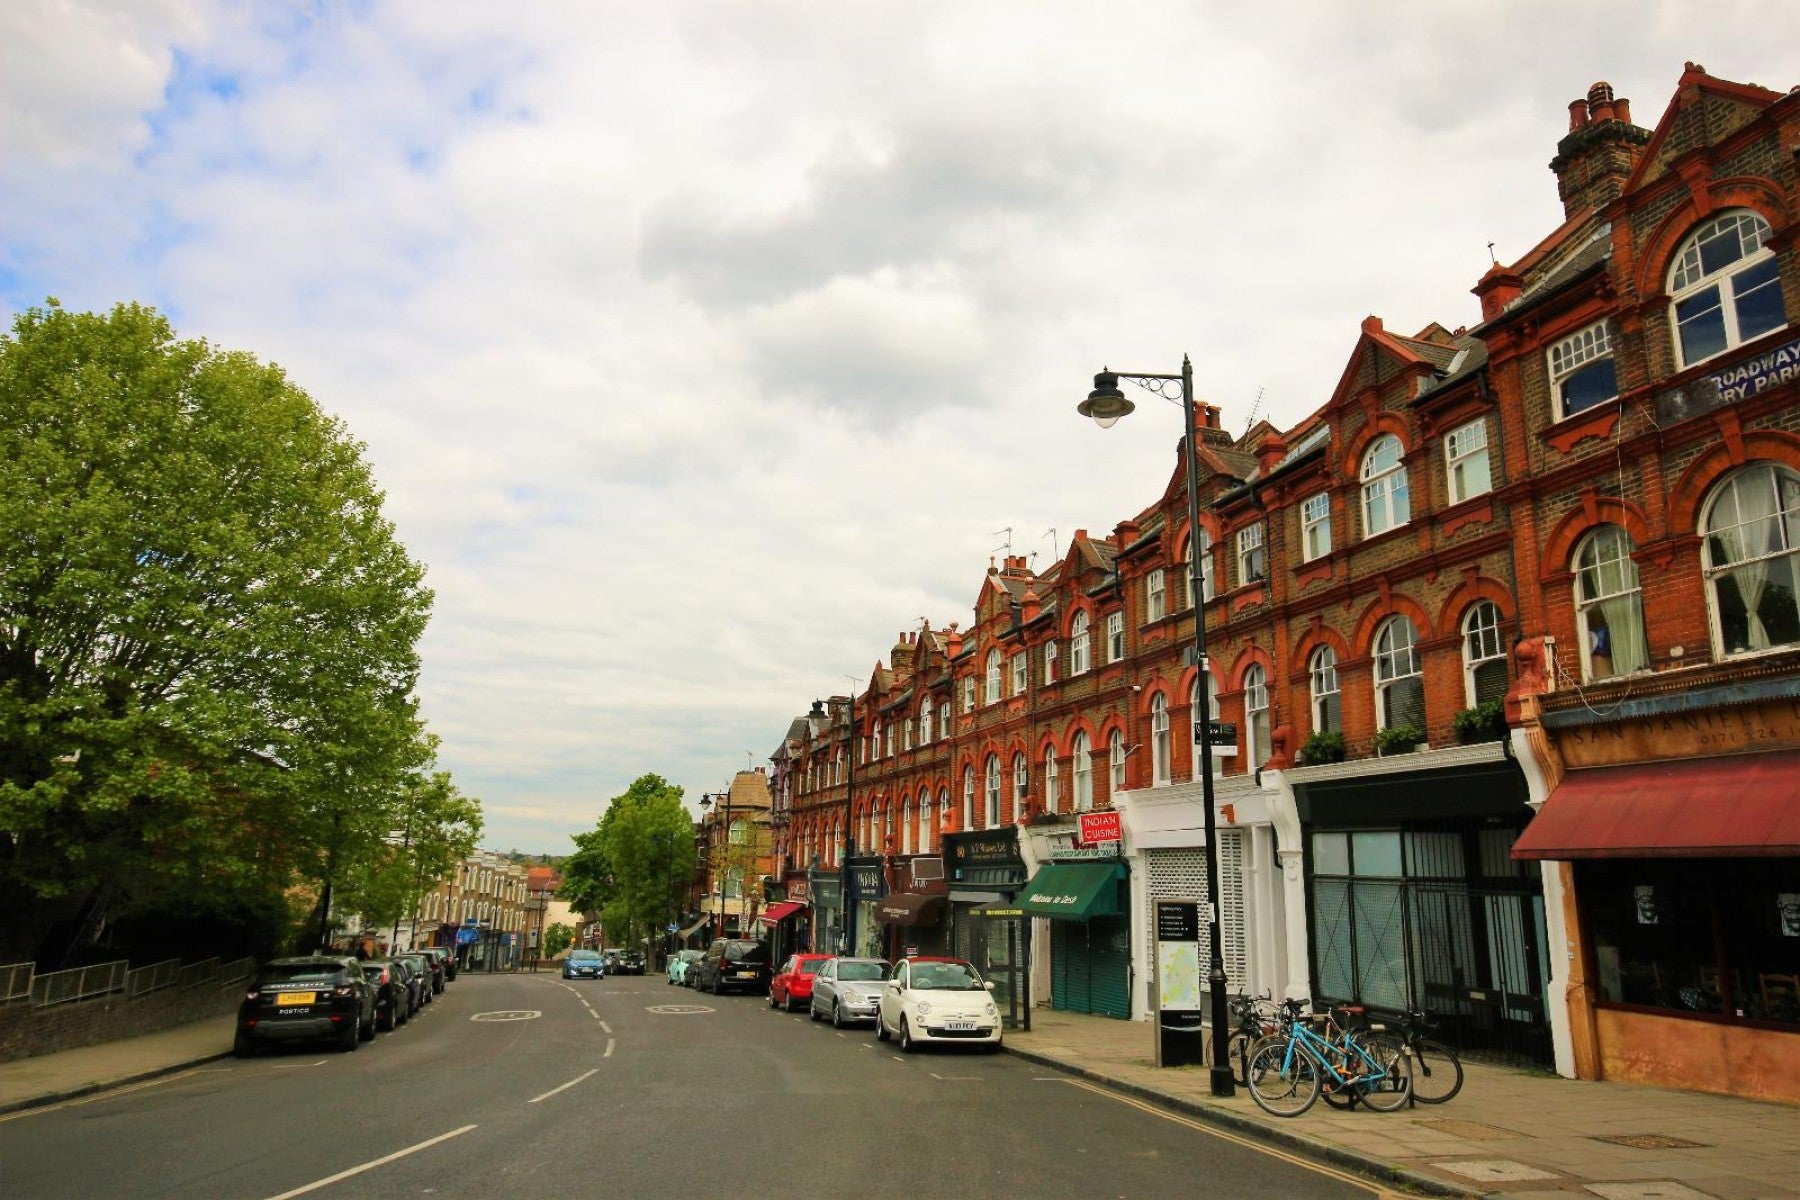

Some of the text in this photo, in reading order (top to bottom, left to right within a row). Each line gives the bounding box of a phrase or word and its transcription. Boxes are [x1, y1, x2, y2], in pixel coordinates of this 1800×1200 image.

[1719, 381, 1749, 404] RY
[1641, 706, 1766, 734] DANIEL
[1084, 816, 1117, 828] INDIAN
[1085, 827, 1119, 839] CUISINE
